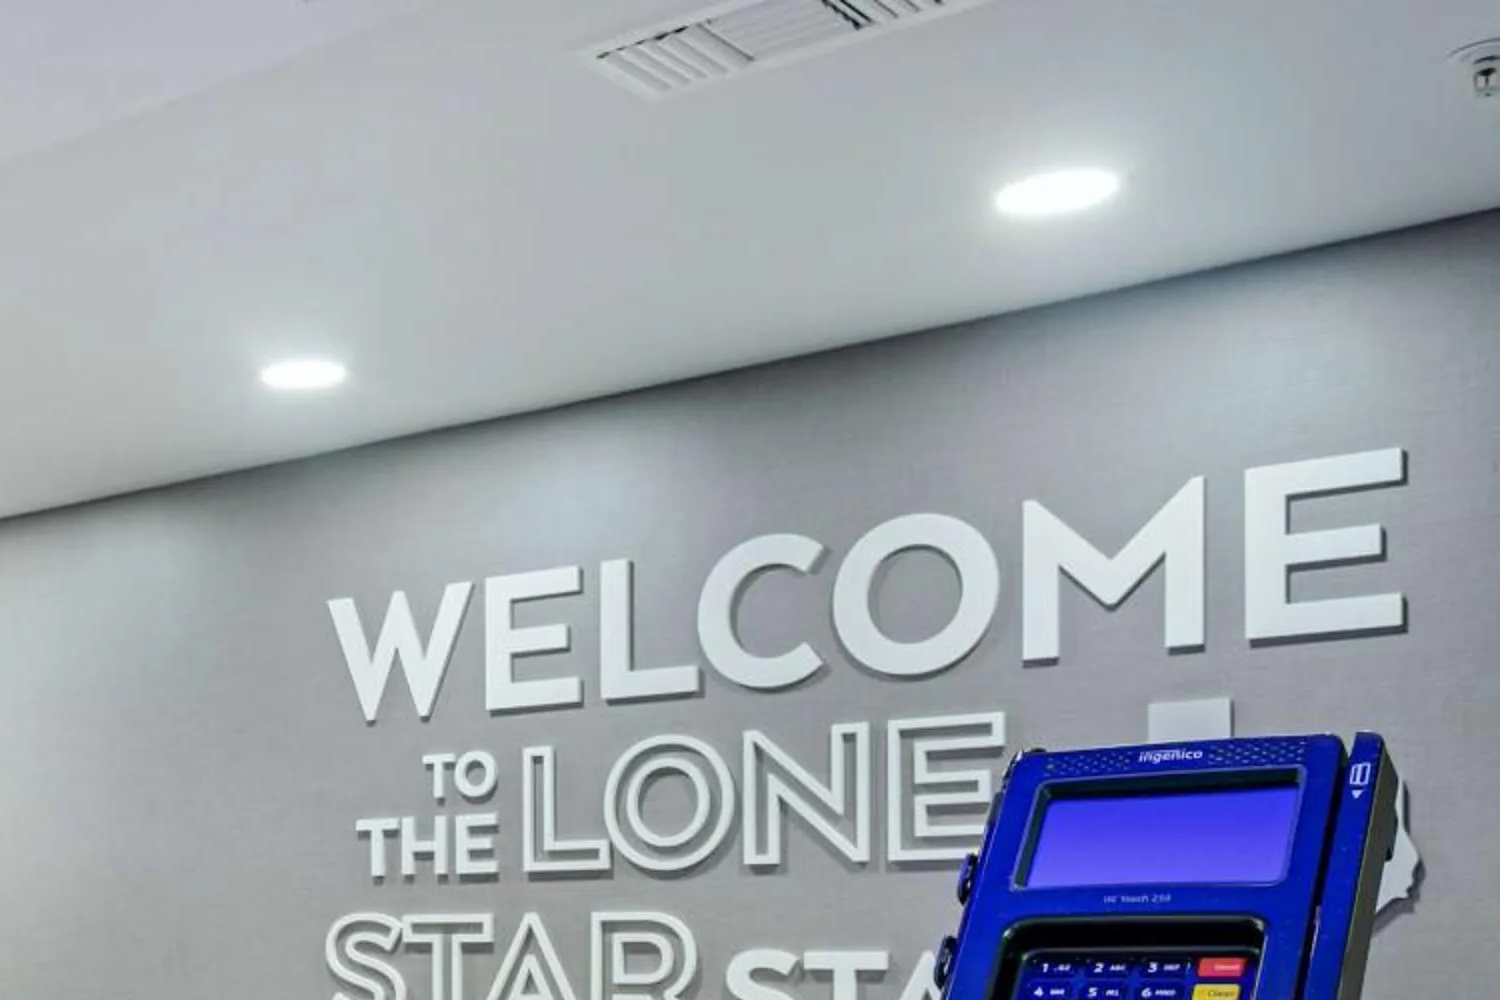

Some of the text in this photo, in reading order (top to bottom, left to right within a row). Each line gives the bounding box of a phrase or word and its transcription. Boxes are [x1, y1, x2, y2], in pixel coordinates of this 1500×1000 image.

[327, 446, 1407, 721] WELCOME
[421, 750, 497, 799] TO
[355, 711, 1005, 877] THE LONE
[1041, 961, 1050, 973] 1
[1092, 961, 1105, 974] 2
[1147, 961, 1159, 974] 3
[1033, 986, 1045, 998] 4
[1086, 986, 1099, 998] 5
[1140, 986, 1153, 998] 6
